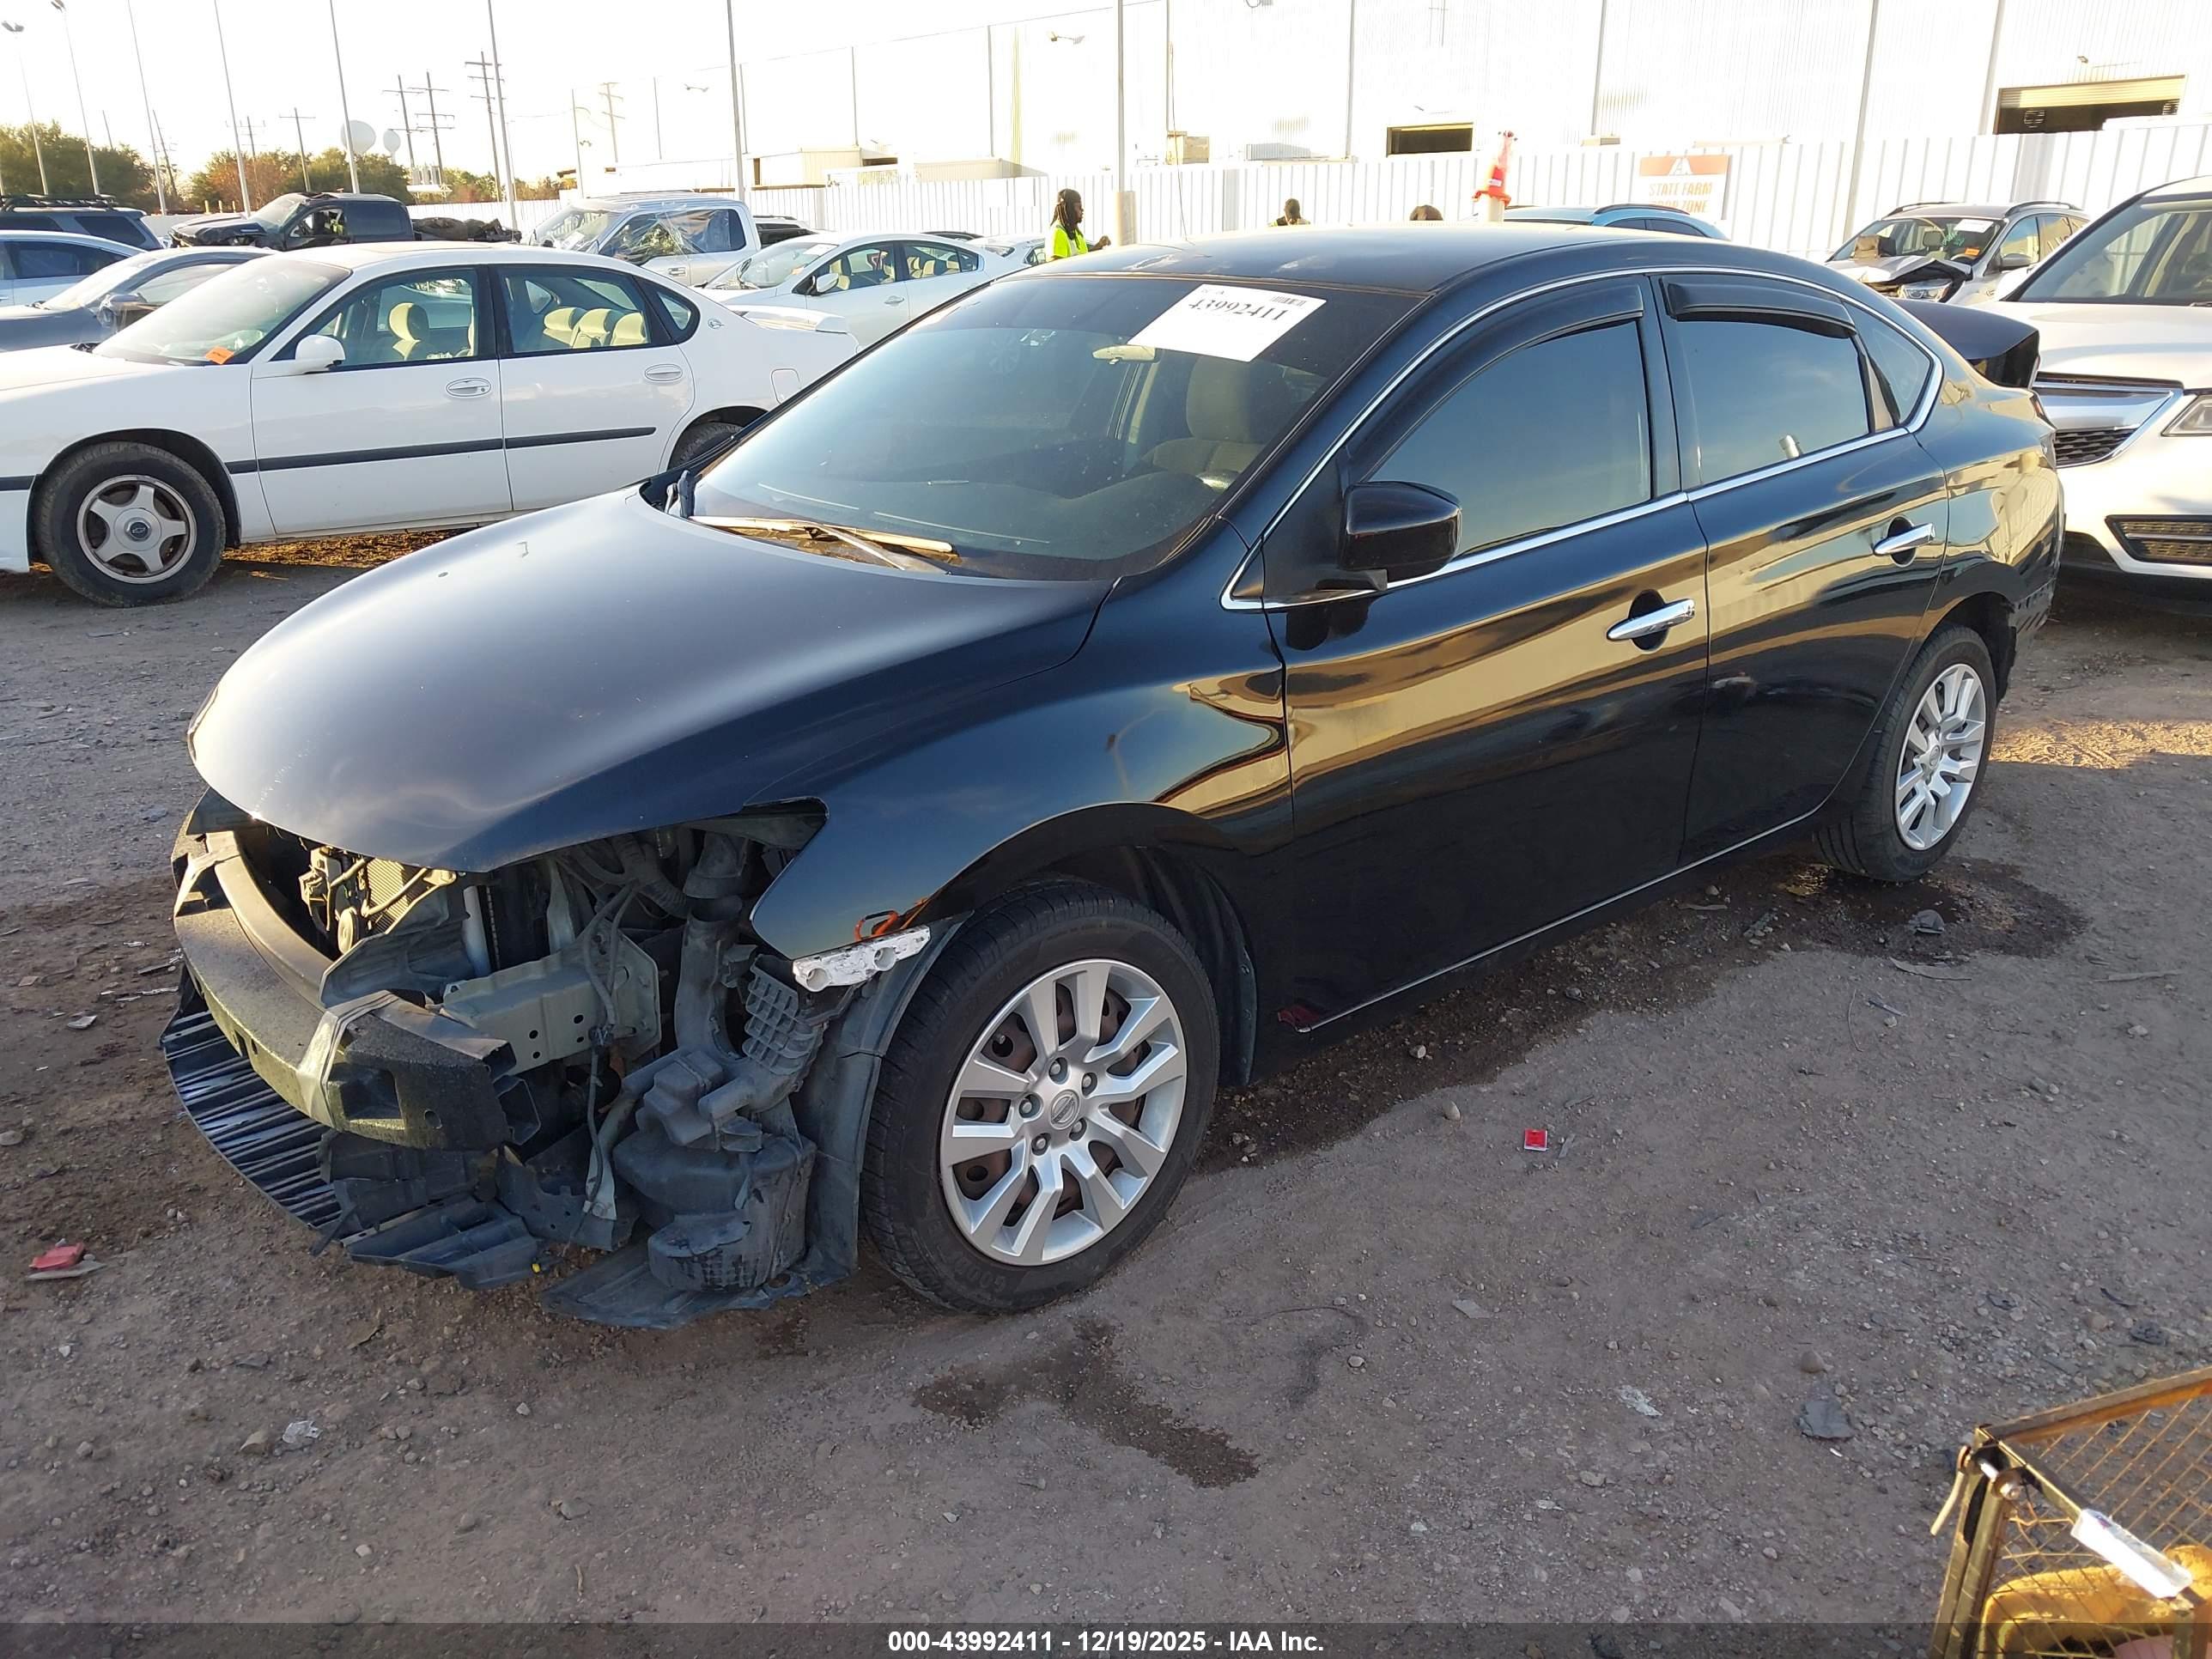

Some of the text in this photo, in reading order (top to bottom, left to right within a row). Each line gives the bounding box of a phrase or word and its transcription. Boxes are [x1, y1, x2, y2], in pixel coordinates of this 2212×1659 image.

[1649, 182, 1712, 197] STATE FARM
[1681, 199, 1708, 213] ZONE
[1188, 299, 1288, 319] 43992411
